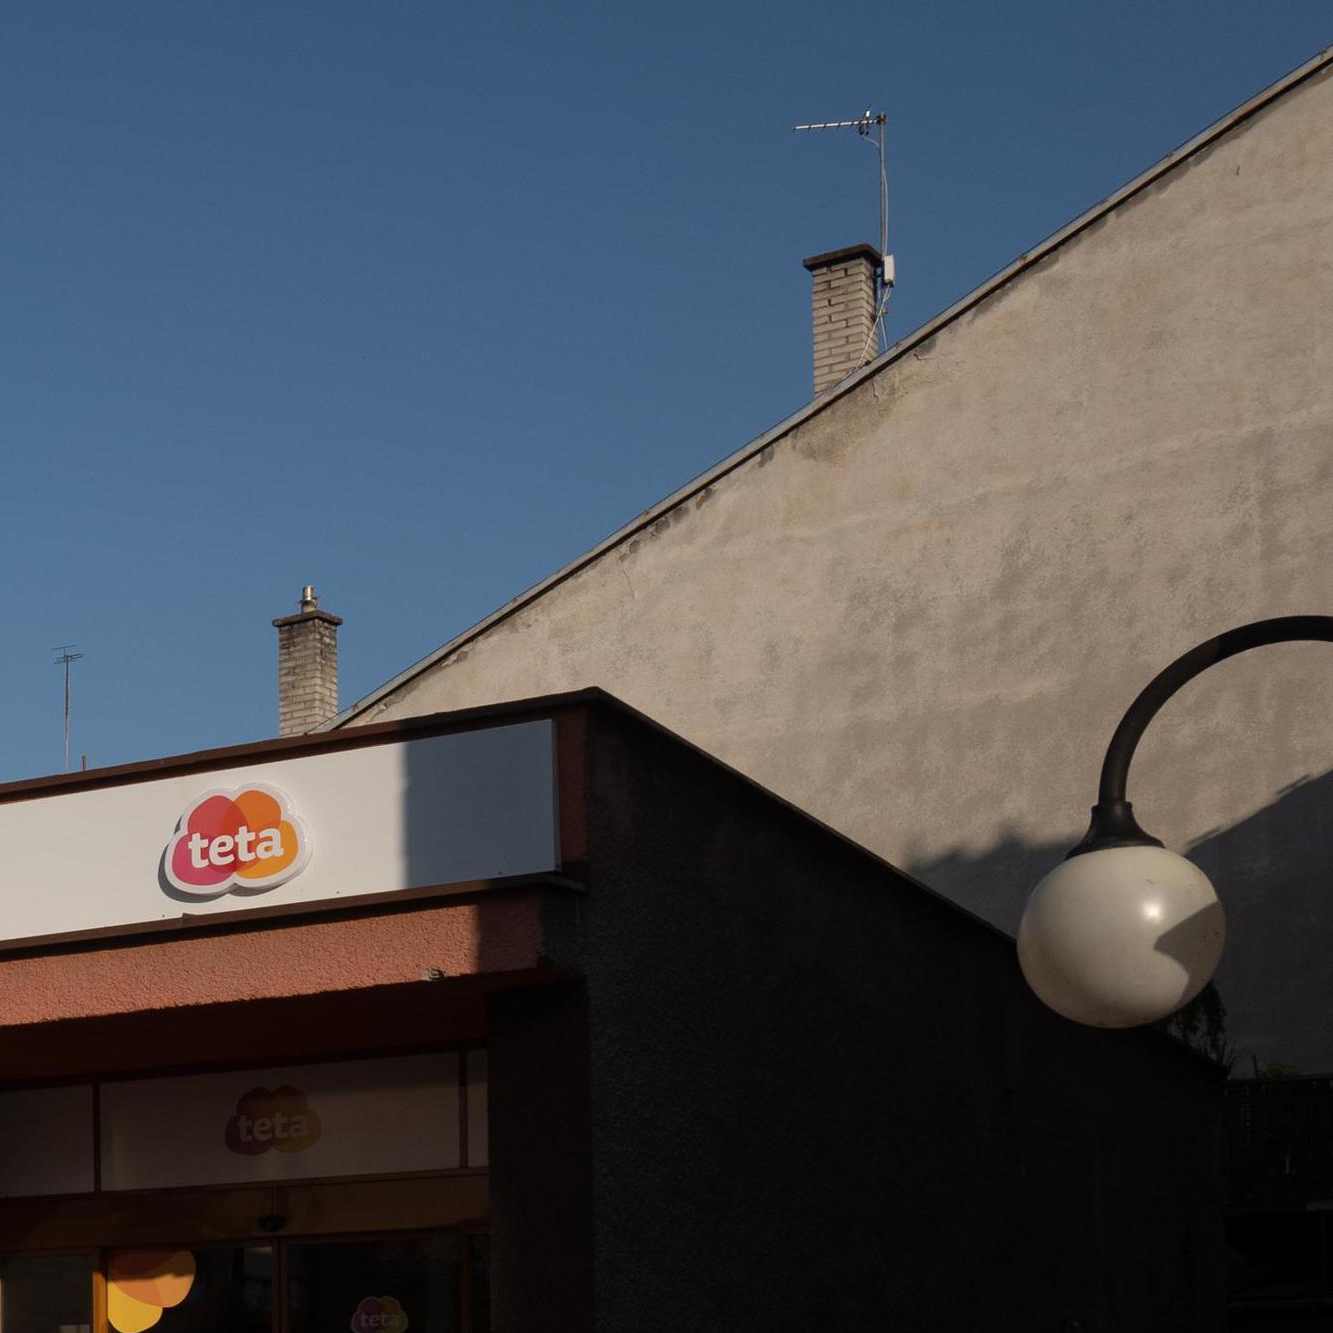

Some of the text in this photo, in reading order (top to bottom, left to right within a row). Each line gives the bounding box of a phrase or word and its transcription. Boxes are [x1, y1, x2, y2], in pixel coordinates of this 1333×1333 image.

[187, 824, 285, 869] teta
[236, 1111, 311, 1143] teta
[359, 1311, 401, 1328] teta
